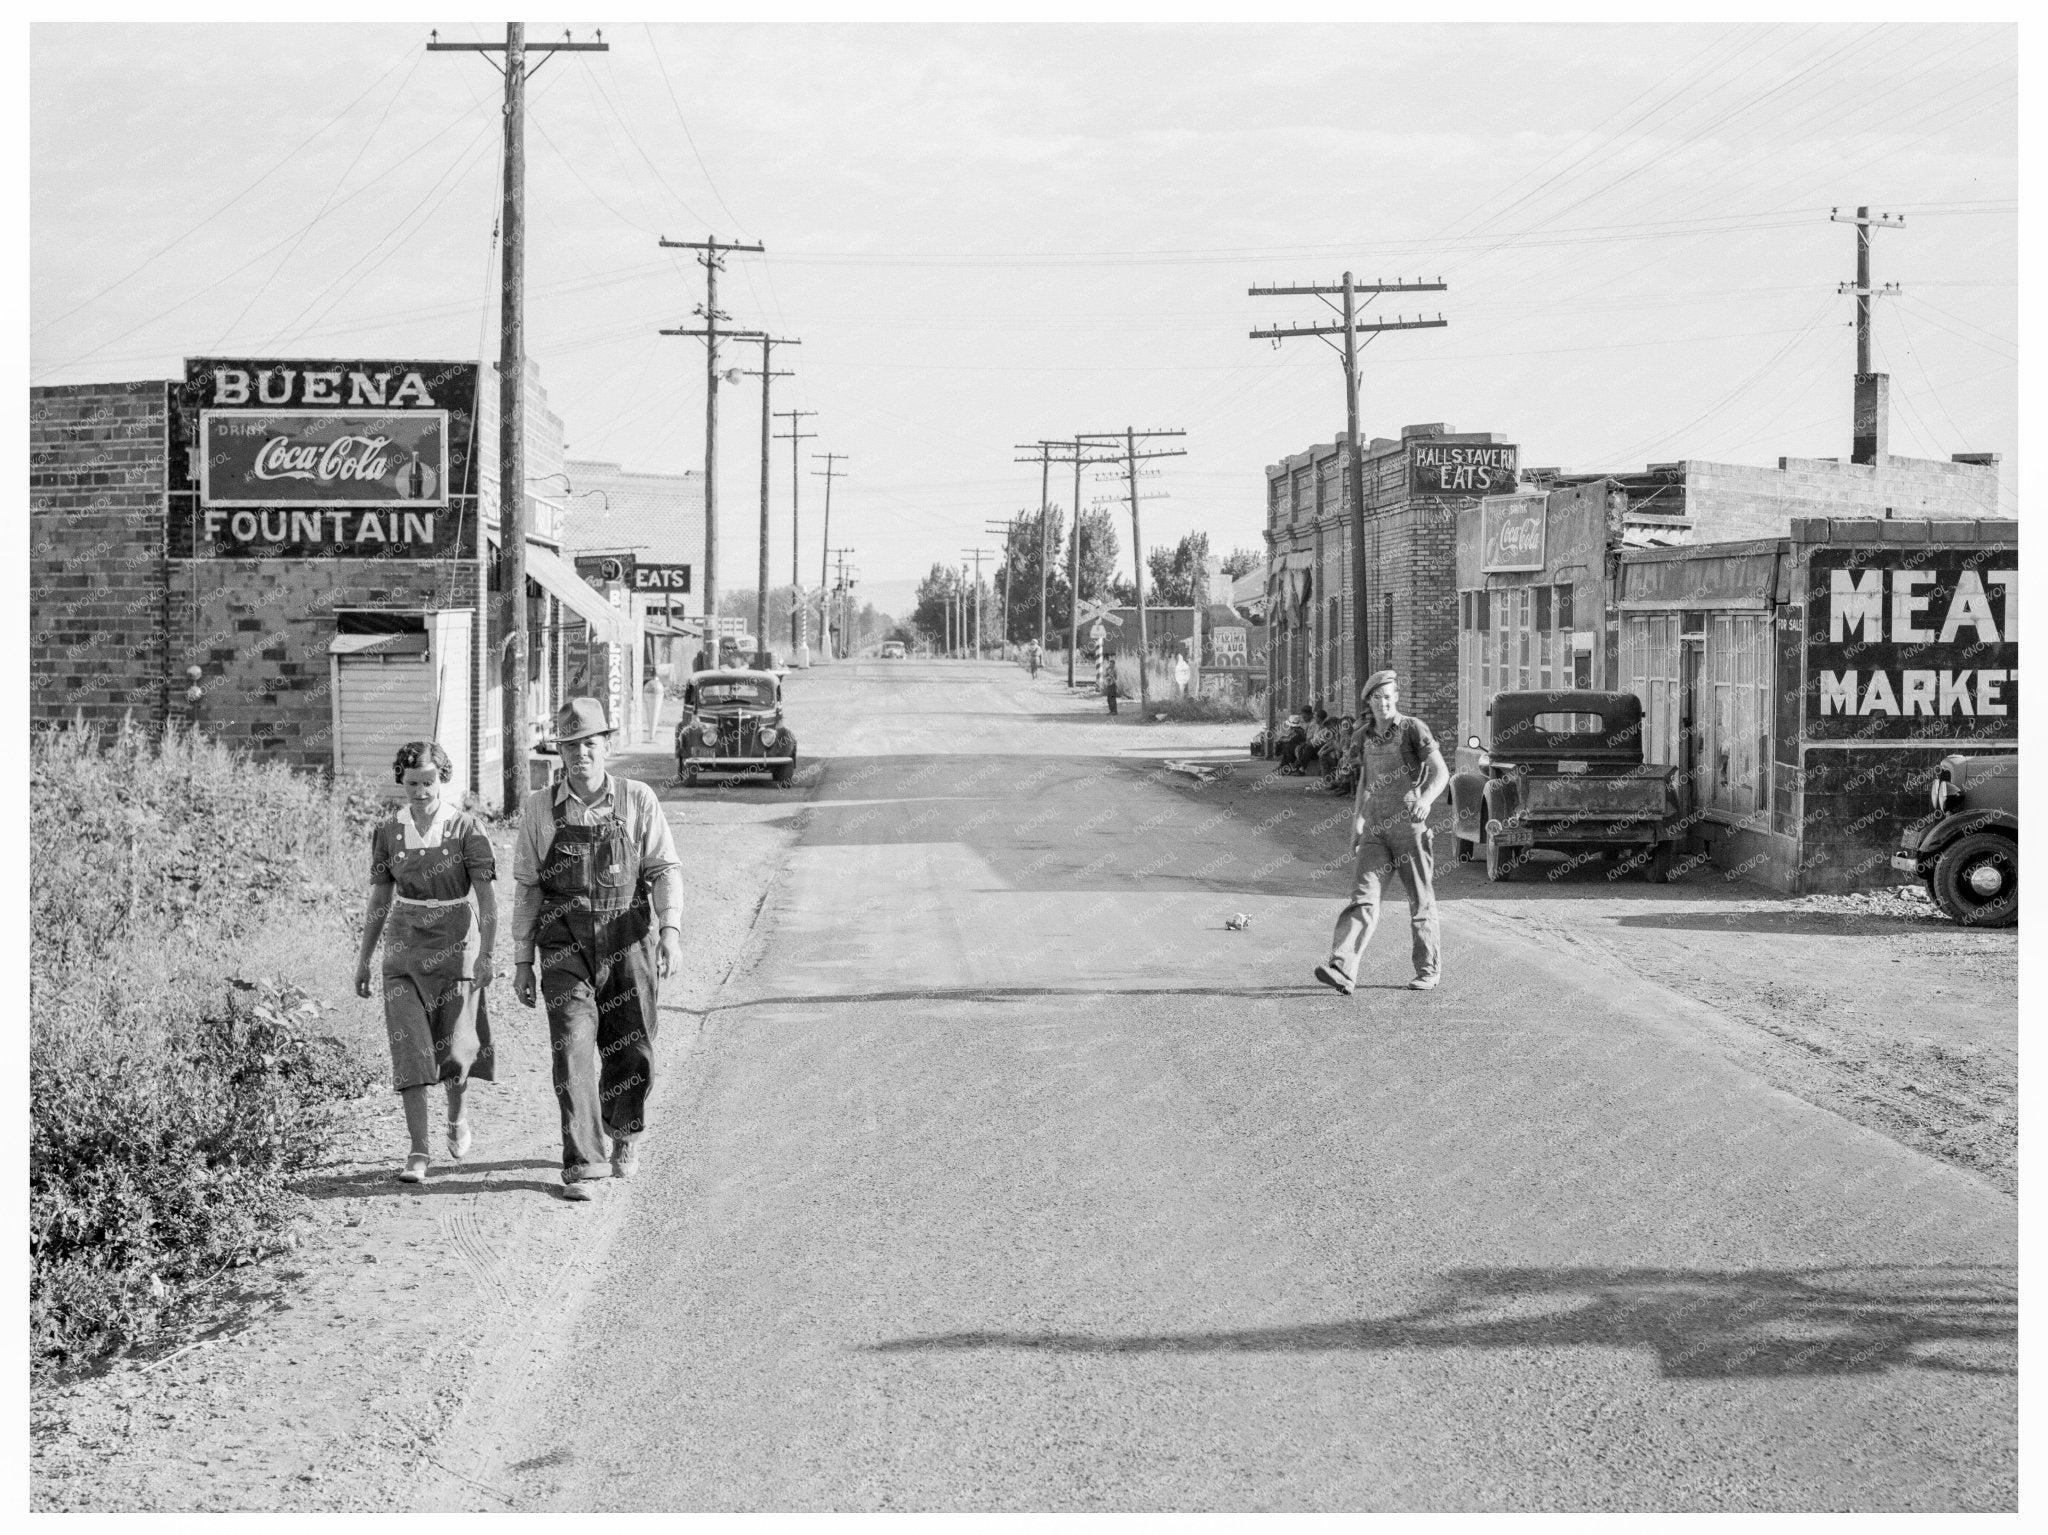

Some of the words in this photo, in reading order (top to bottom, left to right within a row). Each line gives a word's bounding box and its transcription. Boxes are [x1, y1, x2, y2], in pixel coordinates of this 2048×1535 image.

[213, 369, 435, 406] BUENA
[218, 425, 268, 437] DRINK
[254, 435, 393, 481] Coca-Cola
[1441, 465, 1491, 489] EATS
[204, 511, 434, 544] FOUNTAIN
[636, 569, 684, 588] EATS
[1789, 618, 1803, 631] SALE
[609, 590, 621, 729] BERAGES
[1228, 644, 1244, 652] AUG
[1820, 669, 2018, 716] MARKE
